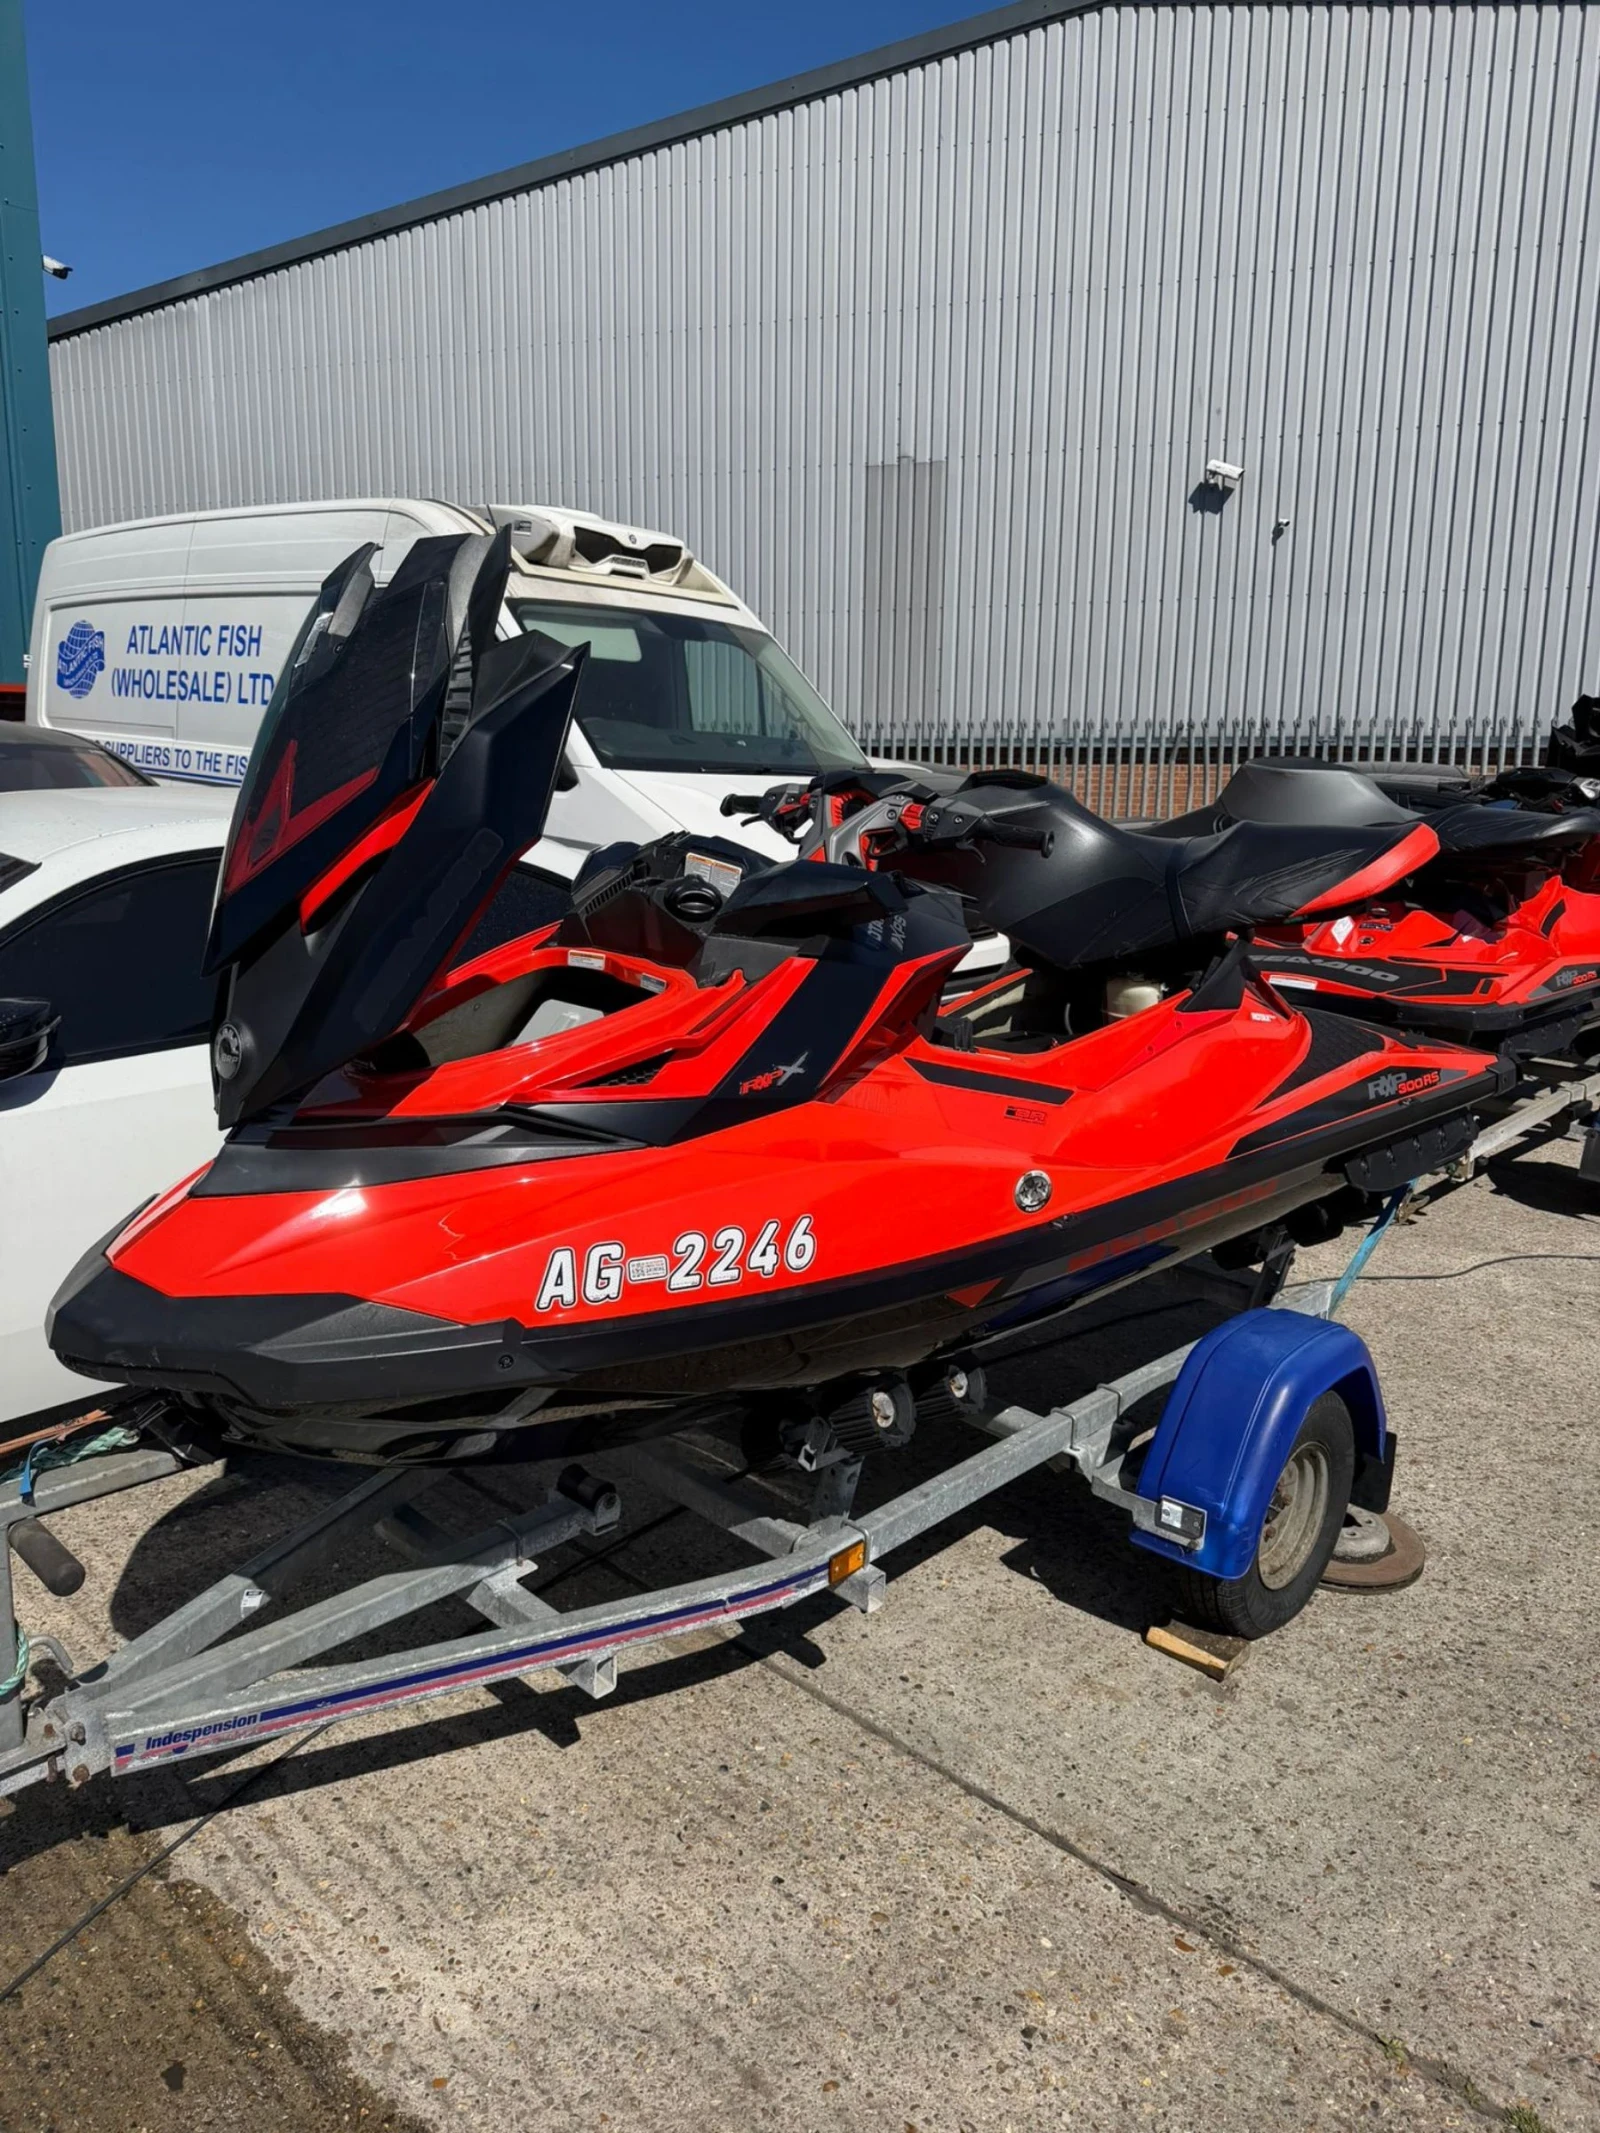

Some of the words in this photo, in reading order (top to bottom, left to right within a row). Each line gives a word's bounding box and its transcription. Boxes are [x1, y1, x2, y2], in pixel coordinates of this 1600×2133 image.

[127, 625, 212, 656] ATLANTIC
[217, 625, 262, 657] FISH
[111, 668, 232, 703] (WHOLESALE)
[237, 673, 275, 705] LTD
[174, 748, 192, 769] TO
[196, 751, 222, 773] THE
[146, 1714, 257, 1749] Indespension
